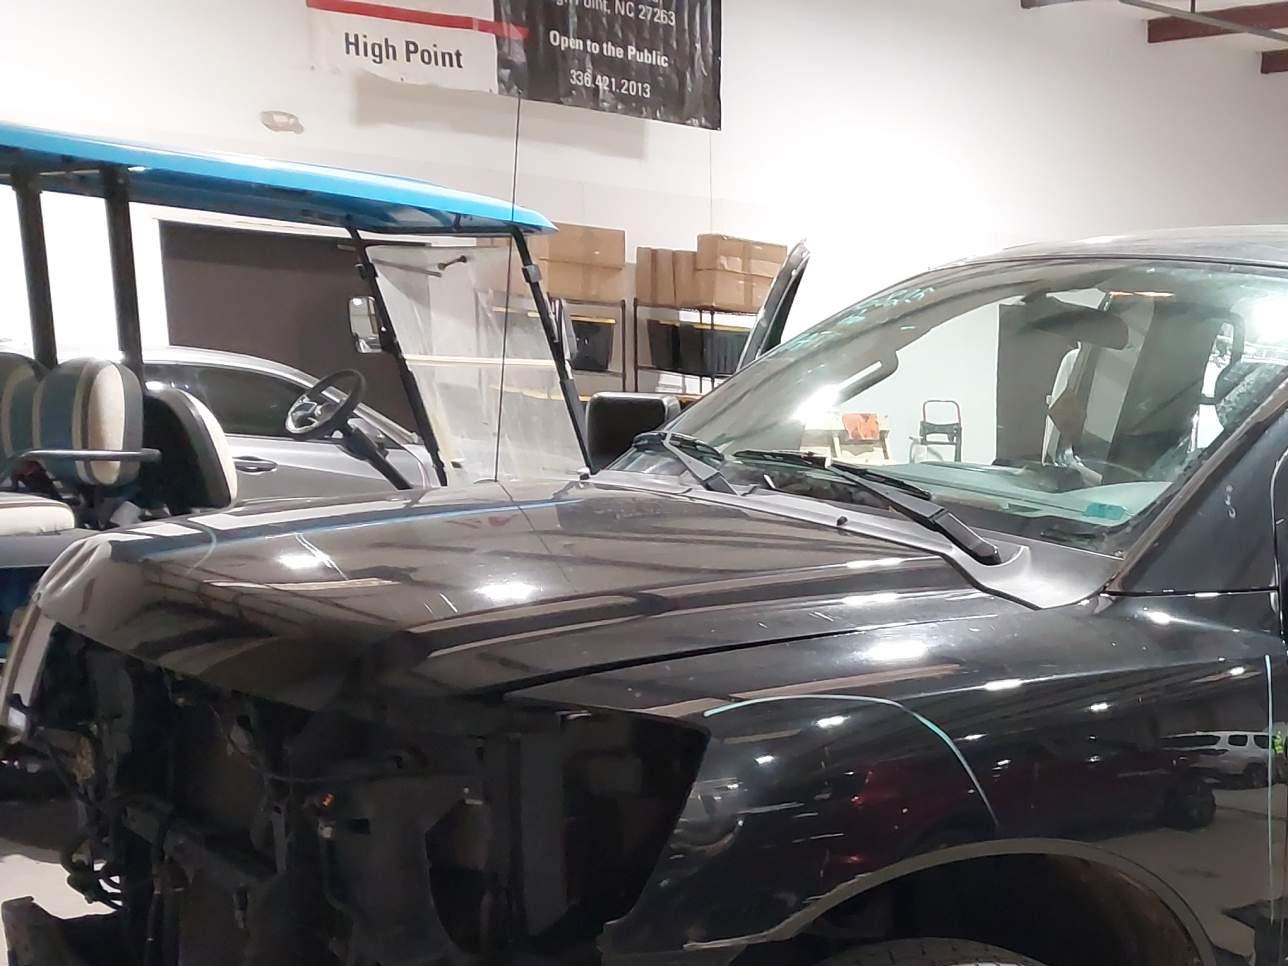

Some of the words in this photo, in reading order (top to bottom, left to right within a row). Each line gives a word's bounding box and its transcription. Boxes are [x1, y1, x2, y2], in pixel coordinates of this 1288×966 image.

[615, 1, 634, 17] NC
[638, 4, 676, 26] 27263
[344, 31, 397, 64] High
[404, 39, 463, 69] Point
[549, 30, 583, 51] Open
[586, 39, 600, 54] to
[602, 41, 624, 58] the
[627, 45, 669, 67] Public
[569, 69, 651, 98] 336.421.2013
